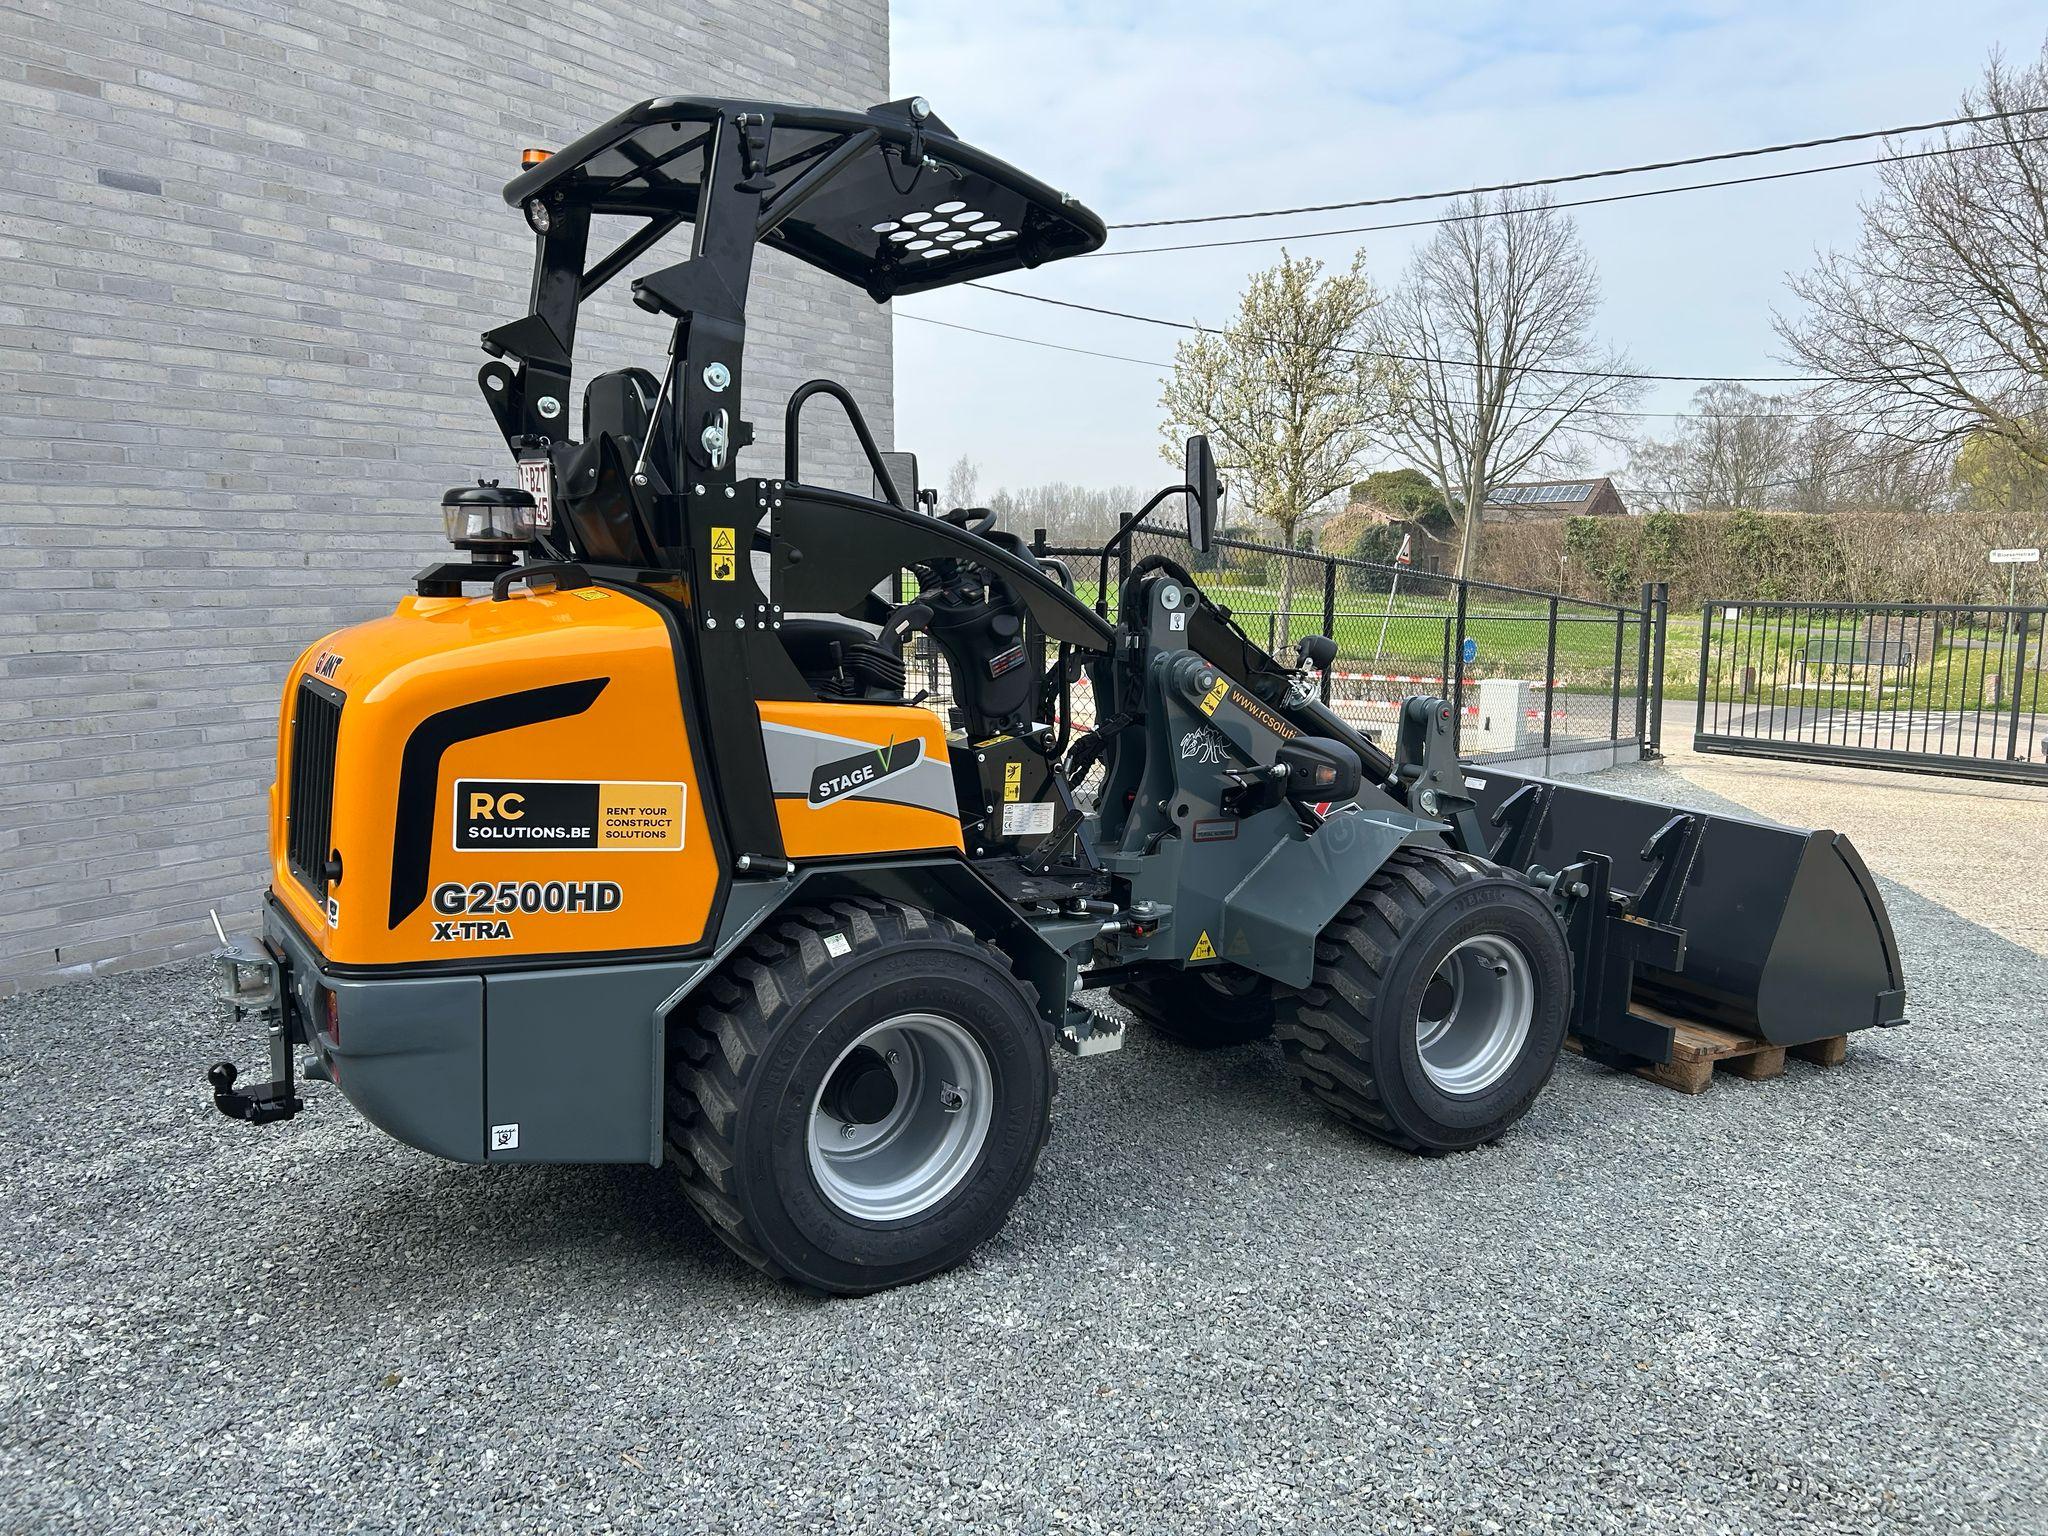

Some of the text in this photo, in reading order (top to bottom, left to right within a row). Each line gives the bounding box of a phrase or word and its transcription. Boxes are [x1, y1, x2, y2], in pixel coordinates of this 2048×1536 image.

[818, 764, 874, 797] STAGE
[469, 792, 526, 821] RC
[606, 807, 667, 816] RENT YOUR
[605, 818, 673, 828] CONSTRUCT
[467, 826, 592, 840] SOLUTIONS.BE
[605, 830, 667, 839] SOLUTIONS
[432, 881, 624, 916] G2500HD
[431, 921, 514, 942] X-TRA
